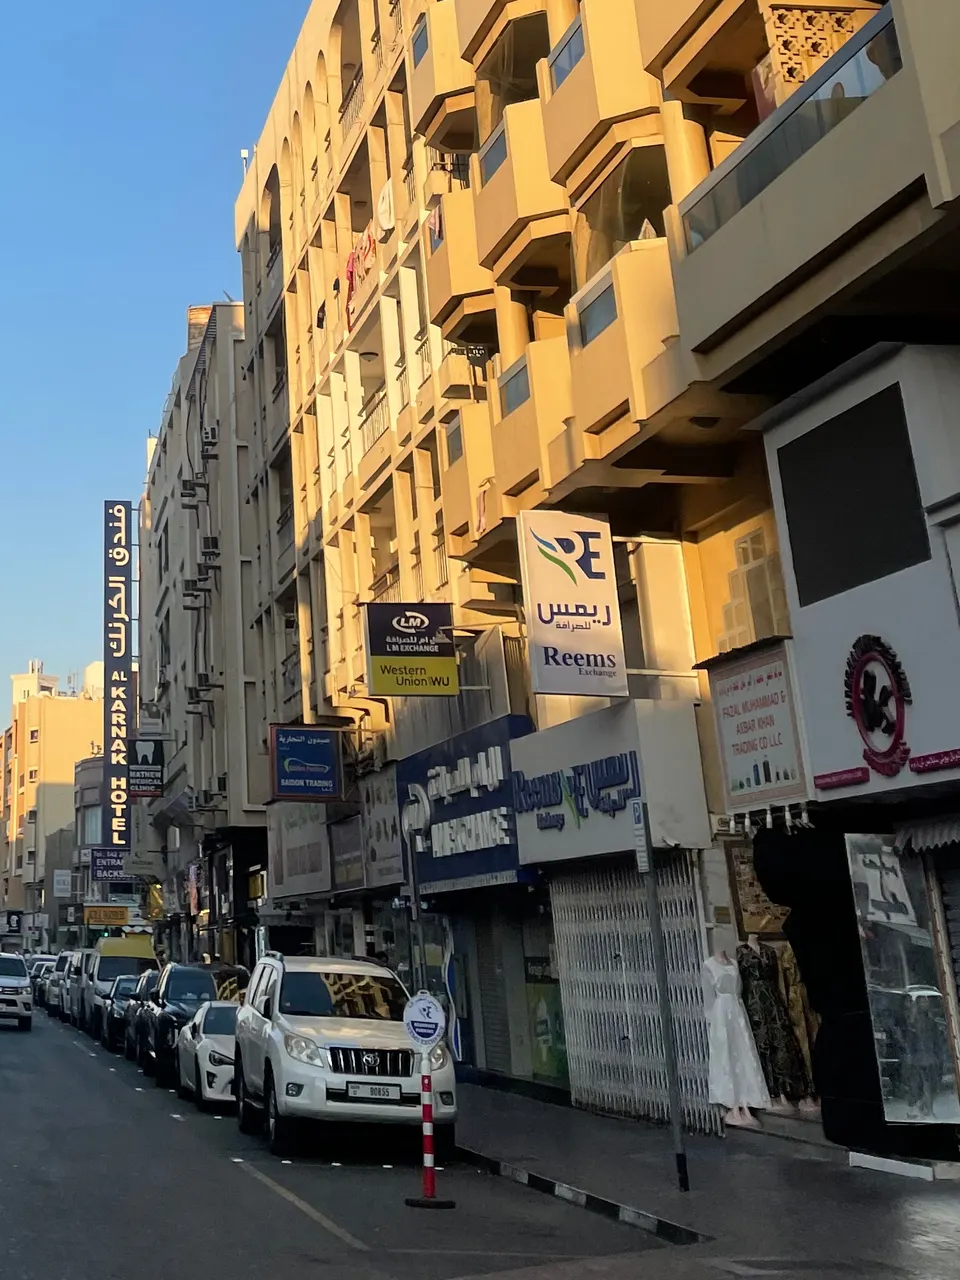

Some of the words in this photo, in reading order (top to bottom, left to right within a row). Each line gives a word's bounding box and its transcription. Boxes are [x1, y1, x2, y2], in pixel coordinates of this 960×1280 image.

[108, 504, 129, 566] فندق
[108, 576, 129, 658] الكرنك
[400, 617, 421, 627] LM
[537, 603, 611, 626] ريمس
[556, 620, 591, 632] للصرافة
[543, 646, 616, 668] Reems
[111, 671, 127, 681] AL
[380, 664, 426, 675] Western
[579, 667, 617, 677] Exchange
[396, 676, 427, 686] Union
[430, 677, 450, 687] WU
[110, 686, 127, 765] KARNAK
[512, 770, 562, 813] Reems
[110, 777, 127, 845] HOTEL
